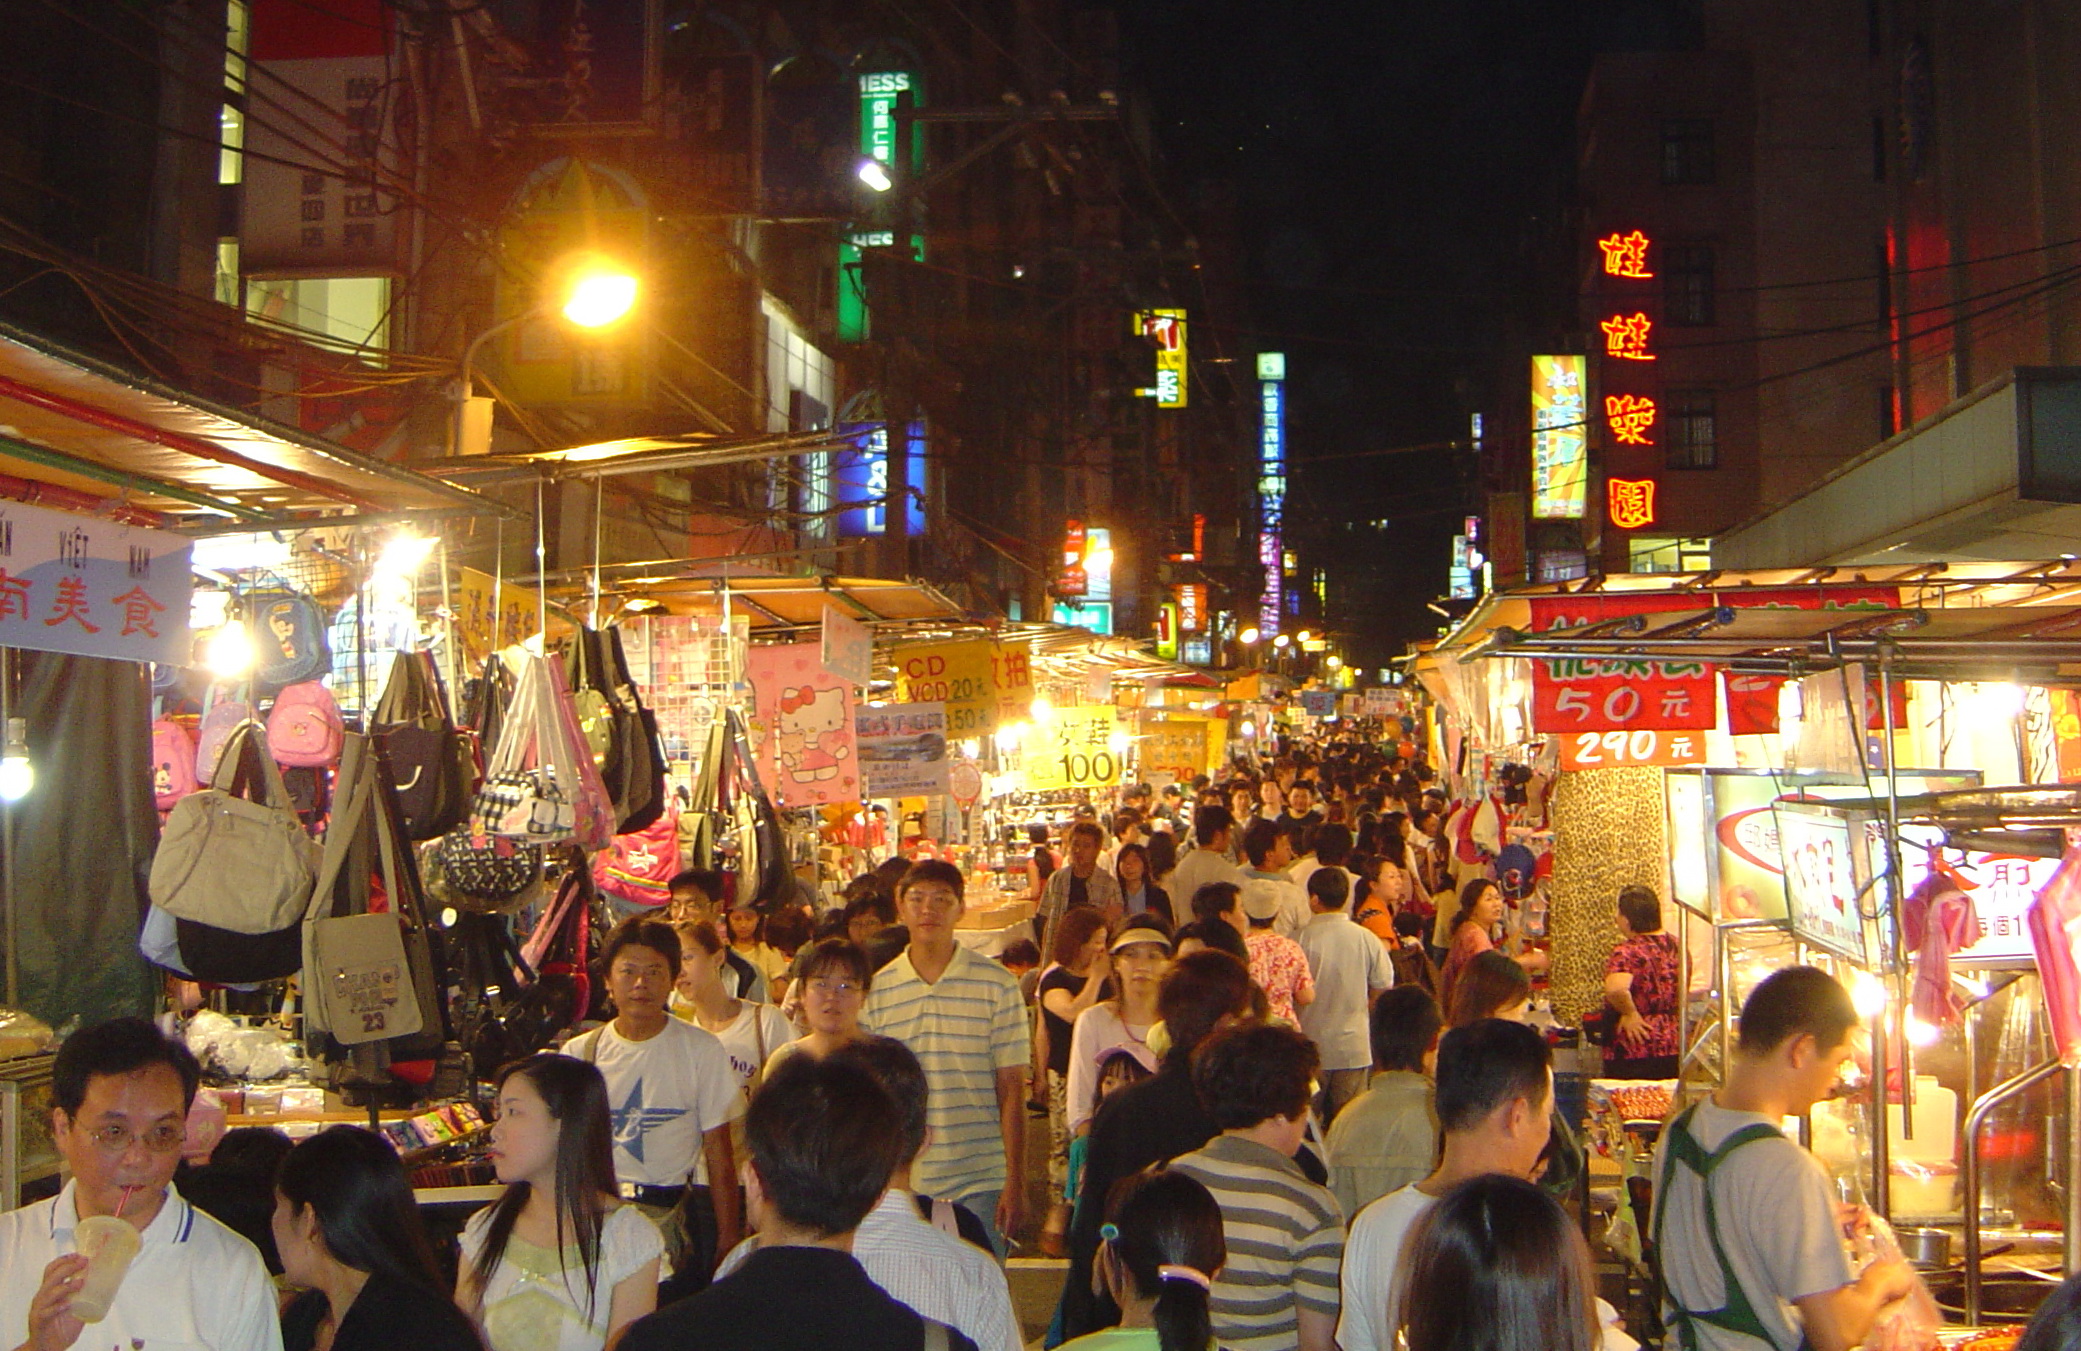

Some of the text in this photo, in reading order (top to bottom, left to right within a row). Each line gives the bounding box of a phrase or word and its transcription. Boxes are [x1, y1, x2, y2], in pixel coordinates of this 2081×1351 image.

[906, 655, 946, 679] CD
[907, 681, 949, 703] VCD
[1555, 686, 1640, 722] 50
[1660, 689, 1692, 718] 元
[1575, 730, 1694, 764] 290 元
[1058, 751, 1114, 783] 100
